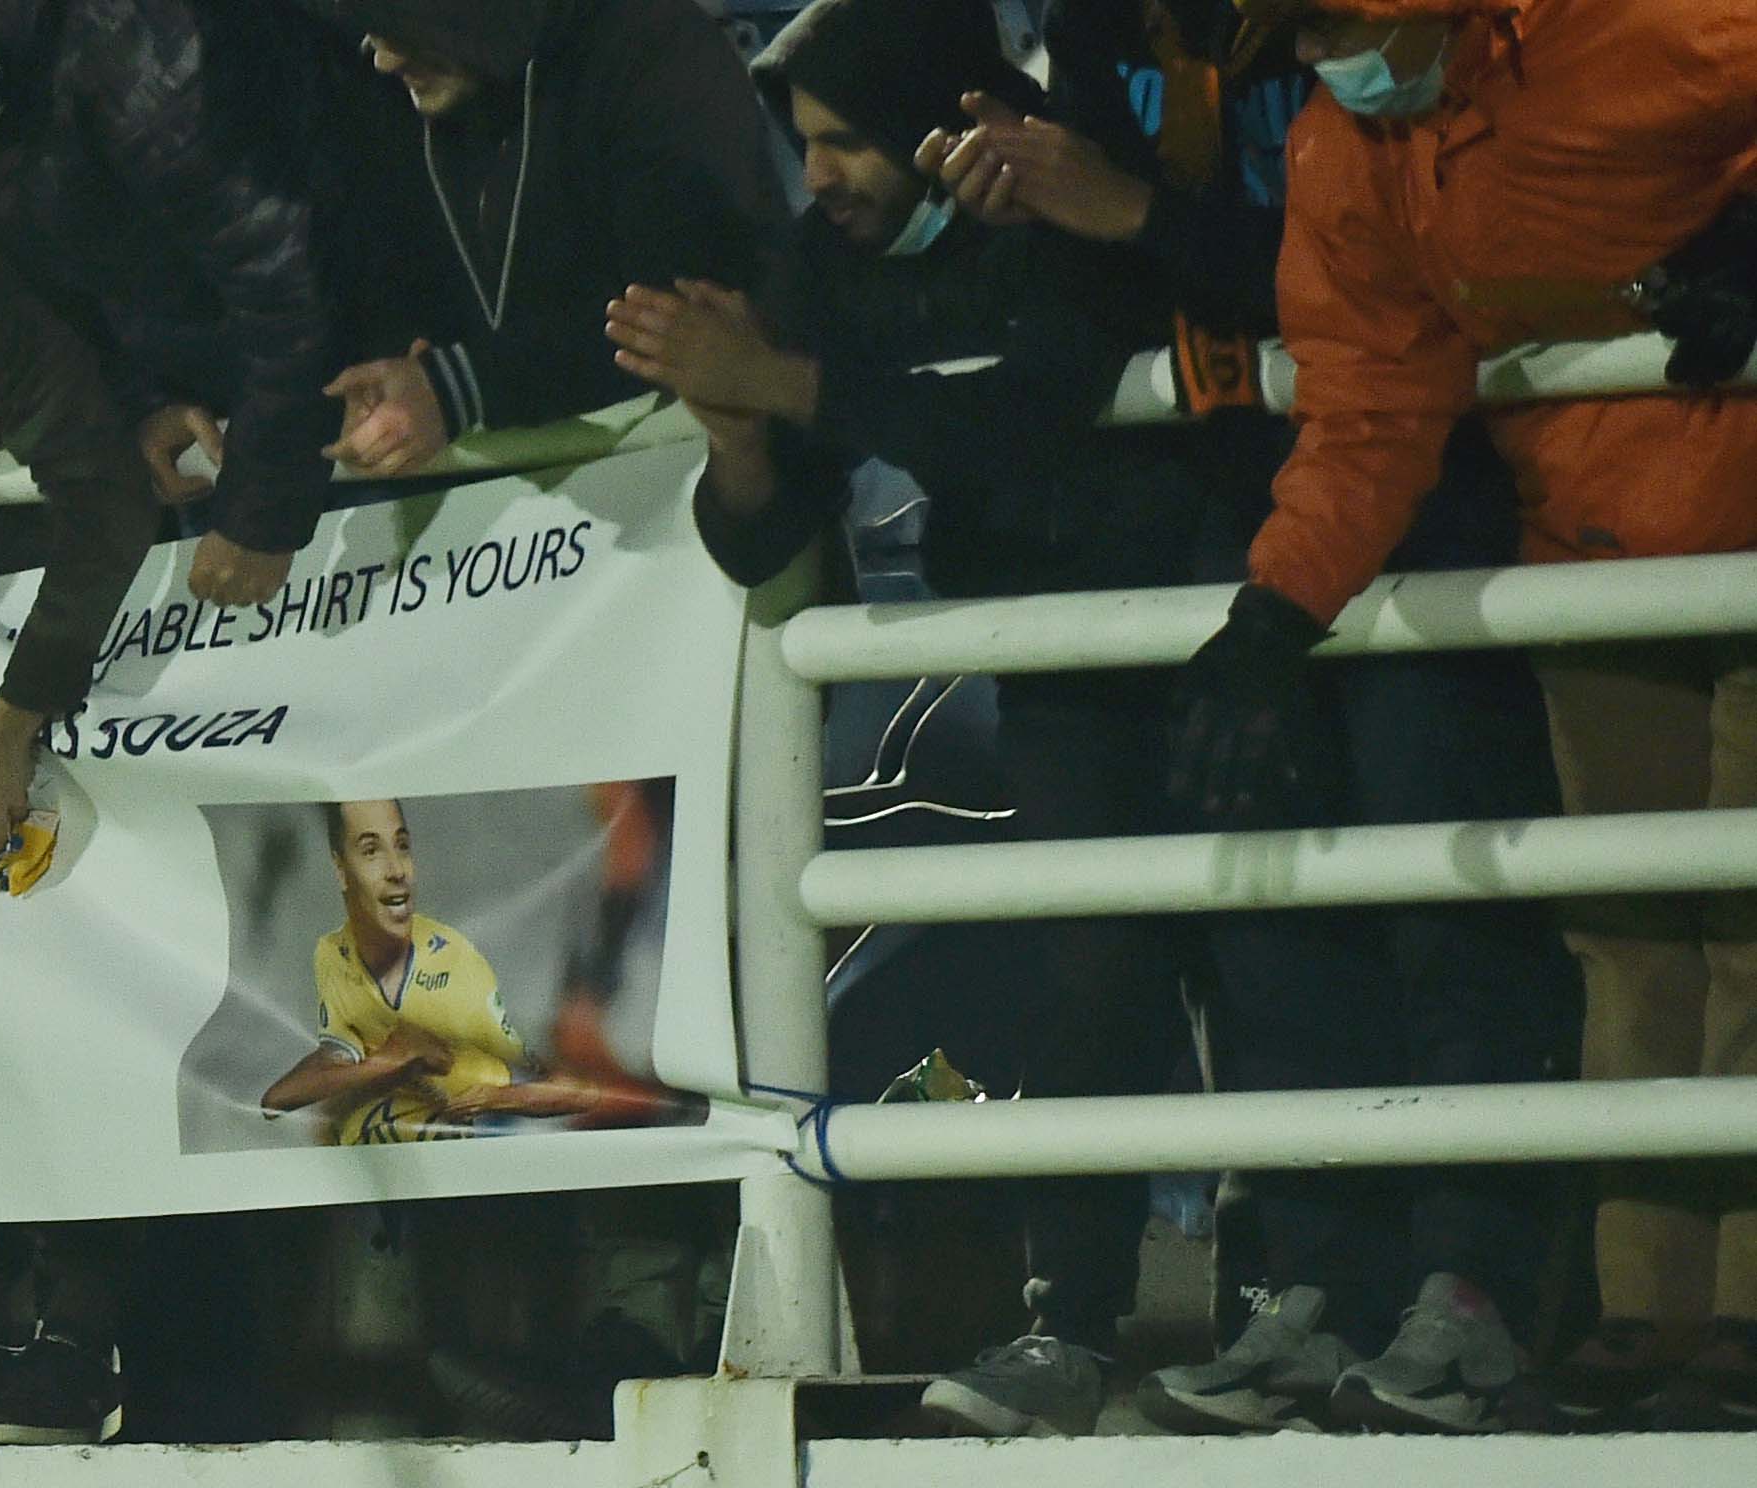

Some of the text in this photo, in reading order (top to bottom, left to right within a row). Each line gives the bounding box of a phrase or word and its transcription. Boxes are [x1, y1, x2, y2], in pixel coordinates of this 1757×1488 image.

[248, 564, 385, 642] SHIRT
[389, 554, 432, 616] IS
[446, 520, 592, 604] YOURS
[91, 704, 289, 760] SOUZA
